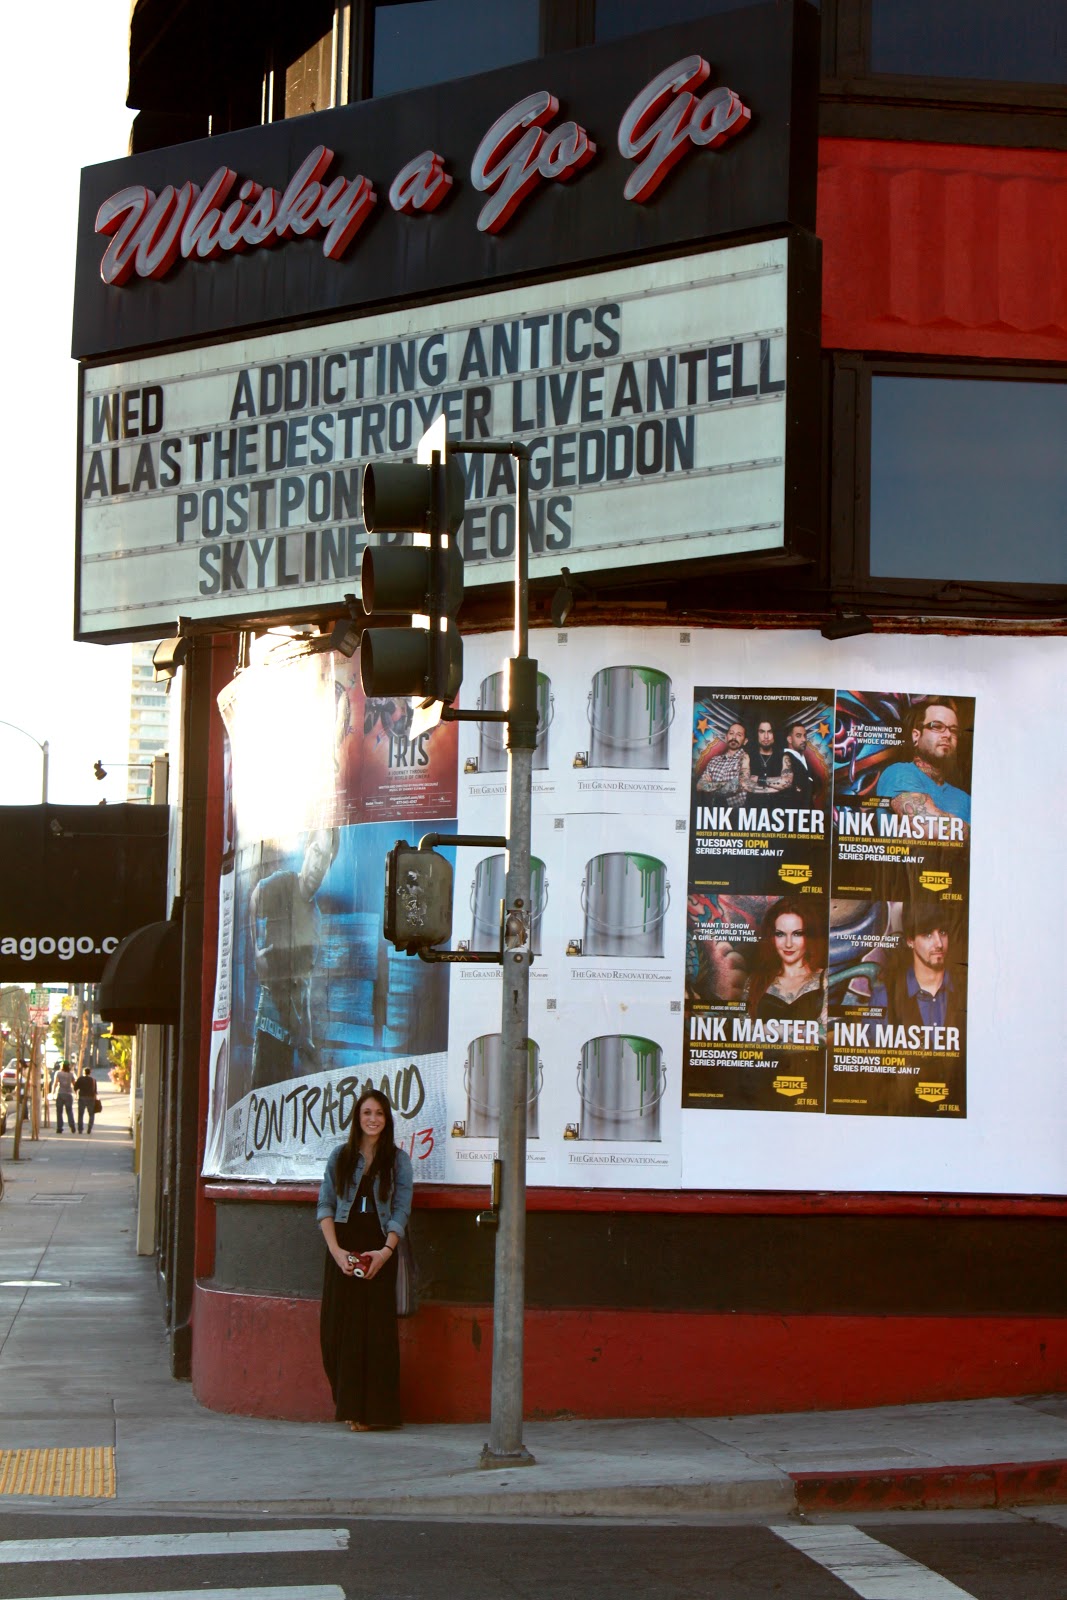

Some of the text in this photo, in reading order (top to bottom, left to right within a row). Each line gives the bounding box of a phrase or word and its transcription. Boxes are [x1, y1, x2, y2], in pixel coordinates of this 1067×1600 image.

[95, 54, 751, 287] Whisky a Go Go
[230, 302, 621, 421] ADDICTING ANTICS
[84, 339, 785, 499] ALAS THE DESTROYER LIVE ANTELL
[91, 385, 164, 444] WED
[177, 415, 695, 542] POSTPON MAGEDDON
[387, 732, 430, 768] IRIS
[696, 806, 825, 834] INK MASTER
[839, 811, 964, 841] INK MASTER
[696, 838, 769, 848] TUESDAYS 10PM
[722, 848, 759, 856] PREMIERE
[838, 844, 910, 855] TUESDAYS 10PM
[864, 854, 901, 862] PREMIERE
[778, 869, 813, 877] SPIKE
[919, 876, 952, 884] SPIKE
[1, 936, 121, 961] agogo.c
[690, 1016, 819, 1044] INK MASTER
[834, 1023, 960, 1050] INK MASTER
[690, 1050, 763, 1060] TUESDAYS 10PM
[834, 1055, 905, 1066] TUESDAYS 10PM
[690, 1059, 715, 1067] SERIES
[716, 1060, 754, 1068] PREMIERE
[755, 1060, 770, 1068] JAN
[898, 1066, 912, 1074] JAN
[773, 1081, 808, 1089] SPIKE
[915, 1087, 949, 1095] SPIKE
